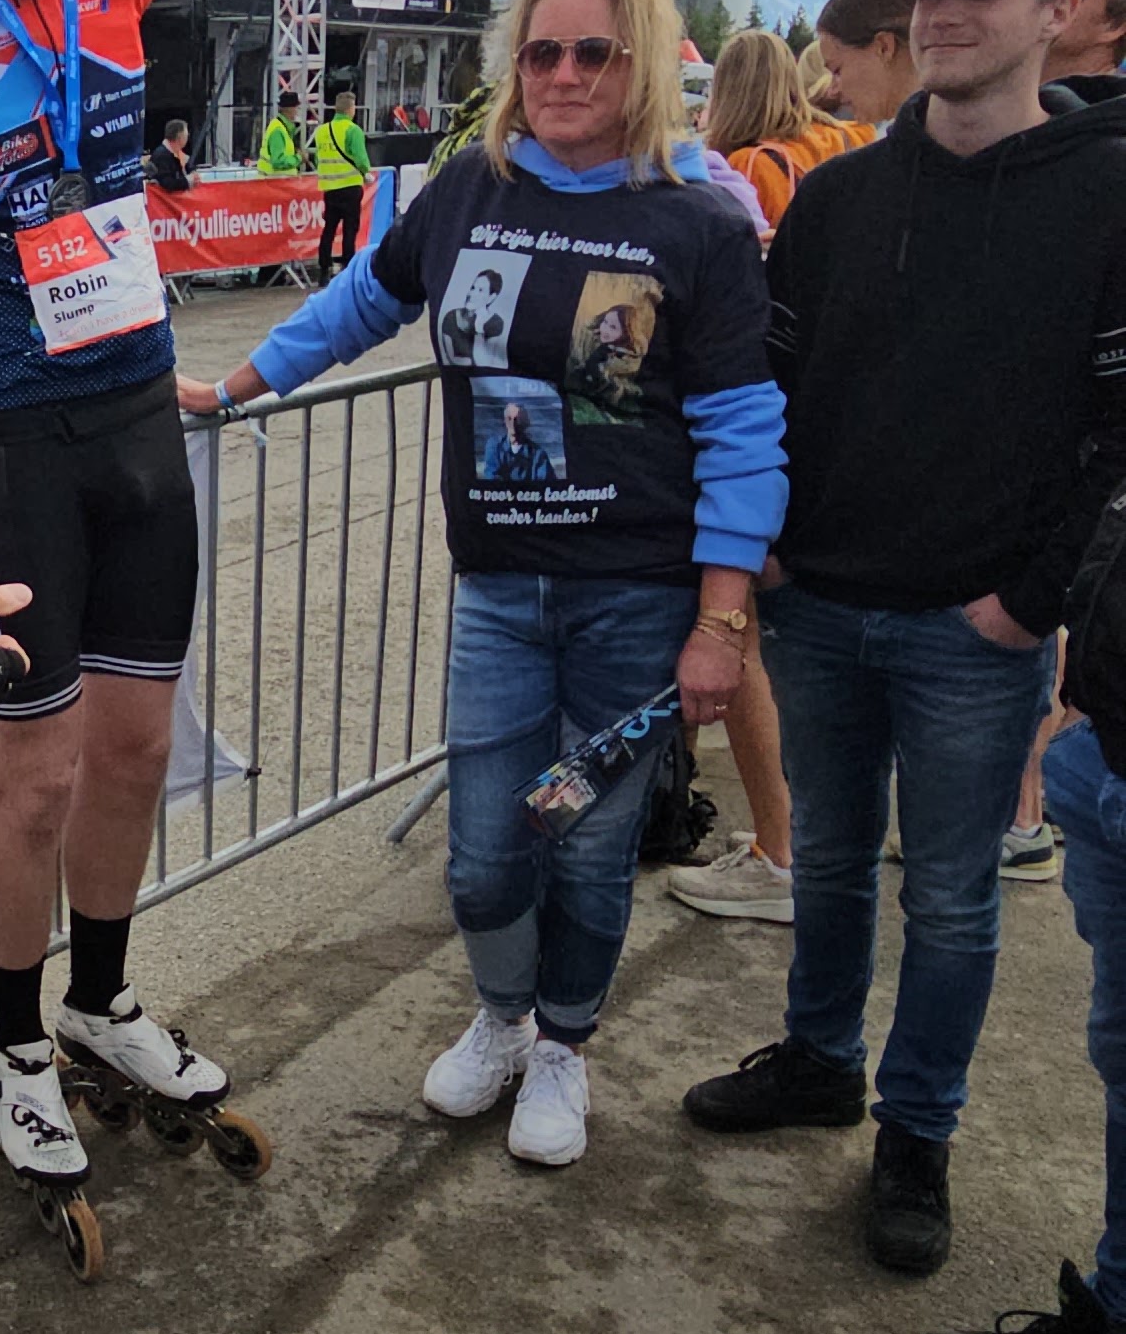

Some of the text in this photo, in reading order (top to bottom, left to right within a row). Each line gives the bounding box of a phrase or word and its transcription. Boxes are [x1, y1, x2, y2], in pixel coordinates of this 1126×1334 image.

[150, 204, 283, 247] ankjulliewel!
[37, 236, 89, 268] 5132
[535, 231, 571, 251] hier
[571, 239, 615, 258] voor
[49, 274, 108, 304] Robin
[54, 304, 95, 324] Slump
[484, 488, 515, 502] voor
[544, 483, 618, 502] toekomst
